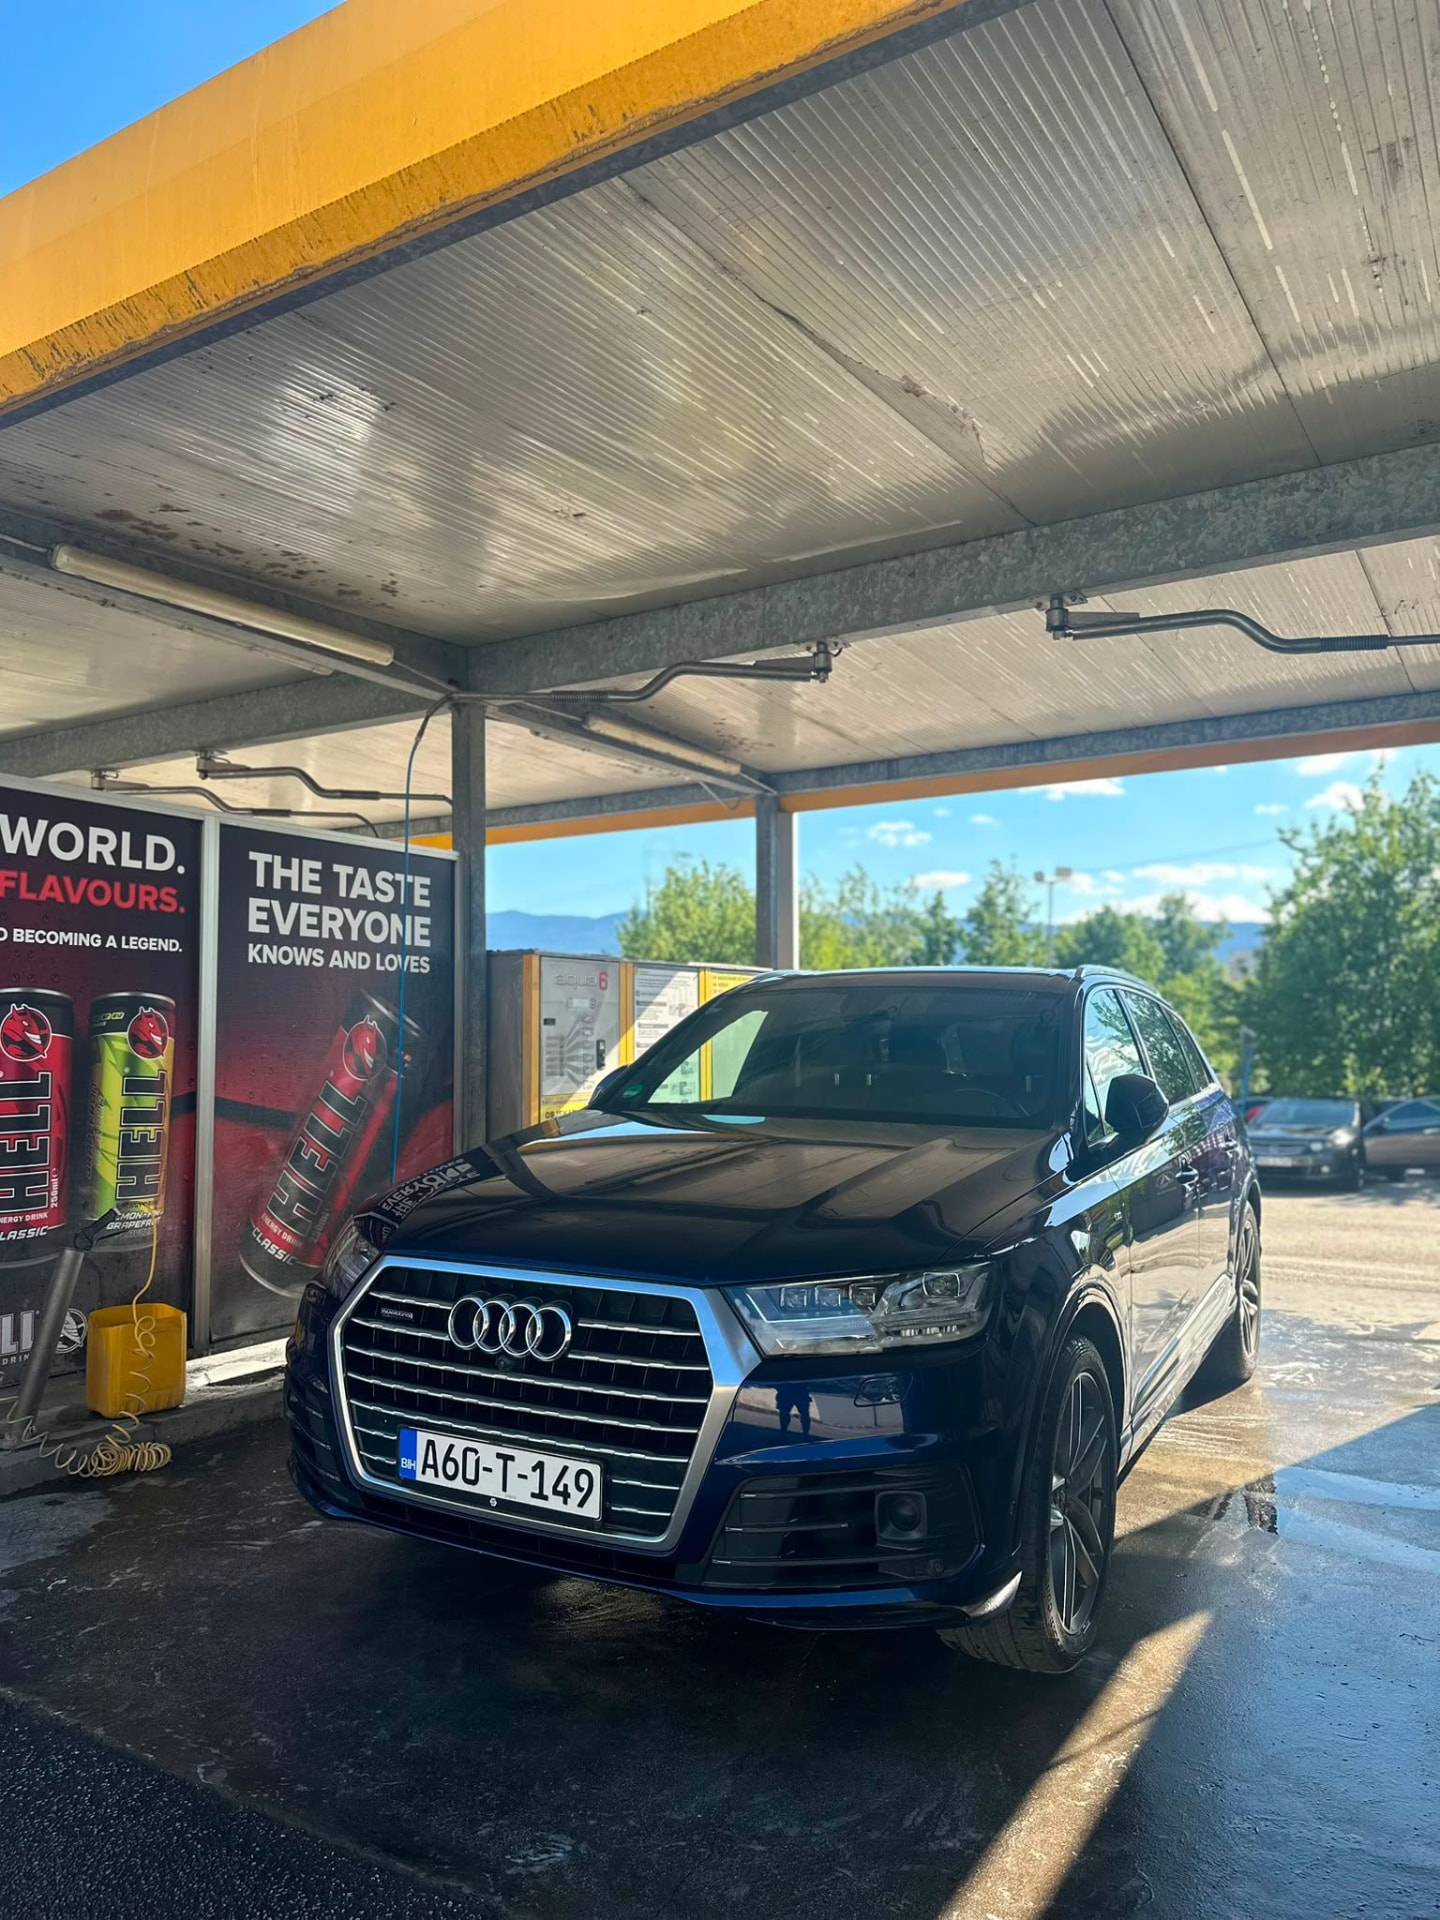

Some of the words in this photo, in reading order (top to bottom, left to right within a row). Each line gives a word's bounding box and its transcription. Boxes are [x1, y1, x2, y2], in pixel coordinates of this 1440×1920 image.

[0, 813, 185, 875] WORLD.
[0, 869, 186, 914] FLAVOURS.
[249, 851, 322, 894] THE
[332, 864, 431, 907] TASTE
[13, 928, 101, 947] BECOMING
[105, 935, 117, 948] A
[121, 936, 183, 952] LEGEND.
[248, 897, 431, 947] EVERYONE
[248, 943, 324, 967] KNOWS
[329, 950, 371, 970] AND
[376, 953, 430, 974] LOVES
[116, 1069, 167, 1200] HELL
[266, 1079, 368, 1237] HELL
[0, 1215, 23, 1224] NERGY
[25, 1211, 48, 1222] DRINK
[0, 1225, 49, 1241] LASSIC
[252, 1227, 299, 1266] CLASSIC
[2, 1353, 30, 1366] DRIN
[401, 1457, 416, 1471] BIH
[421, 1439, 594, 1508] A60-T-149
